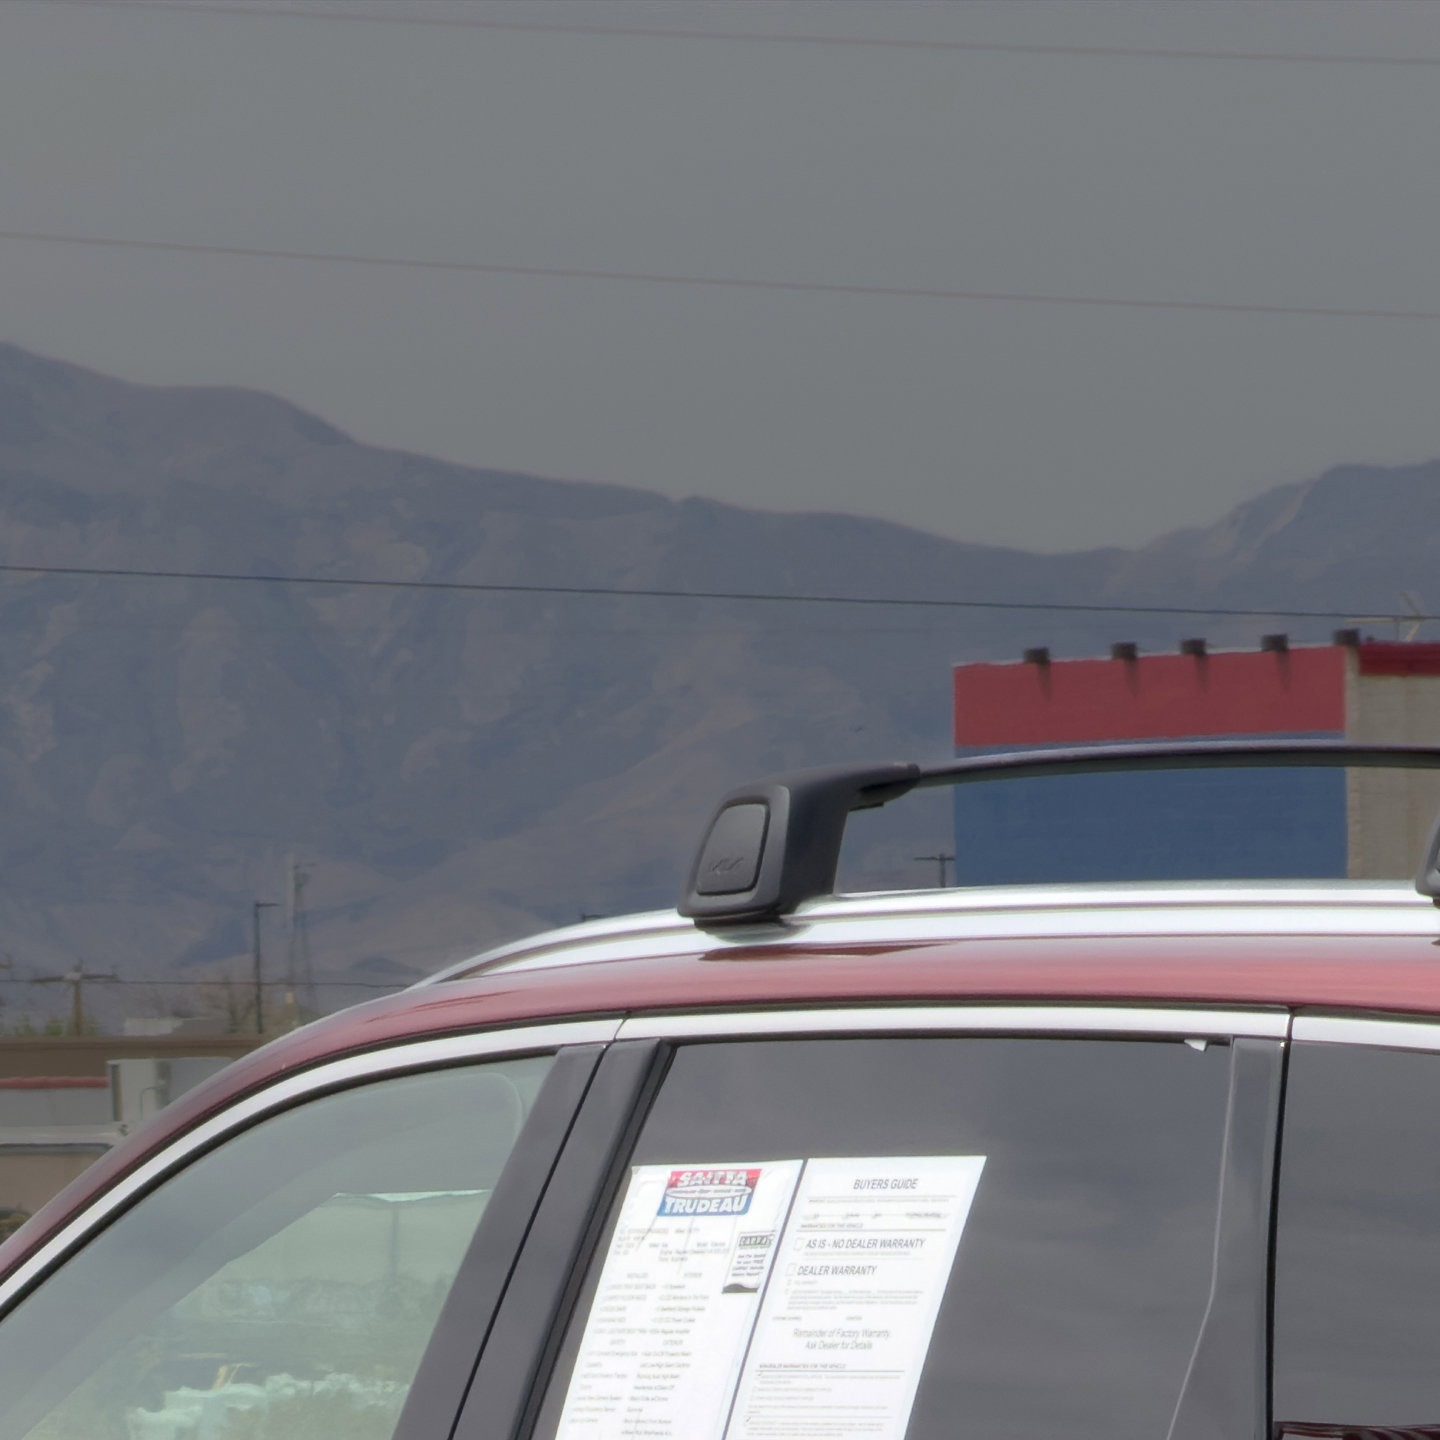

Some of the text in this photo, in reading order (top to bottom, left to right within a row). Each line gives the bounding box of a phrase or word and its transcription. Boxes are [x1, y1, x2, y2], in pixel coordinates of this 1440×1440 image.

[853, 1178, 919, 1190] BUYERS GUIDE
[663, 1195, 747, 1214] TRUDEAU
[805, 1239, 817, 1249] AS
[832, 1239, 845, 1248] NO
[845, 1239, 878, 1249] DEALER
[879, 1238, 926, 1249] WARRANTY
[797, 1265, 877, 1276] DEALER WARRANTY
